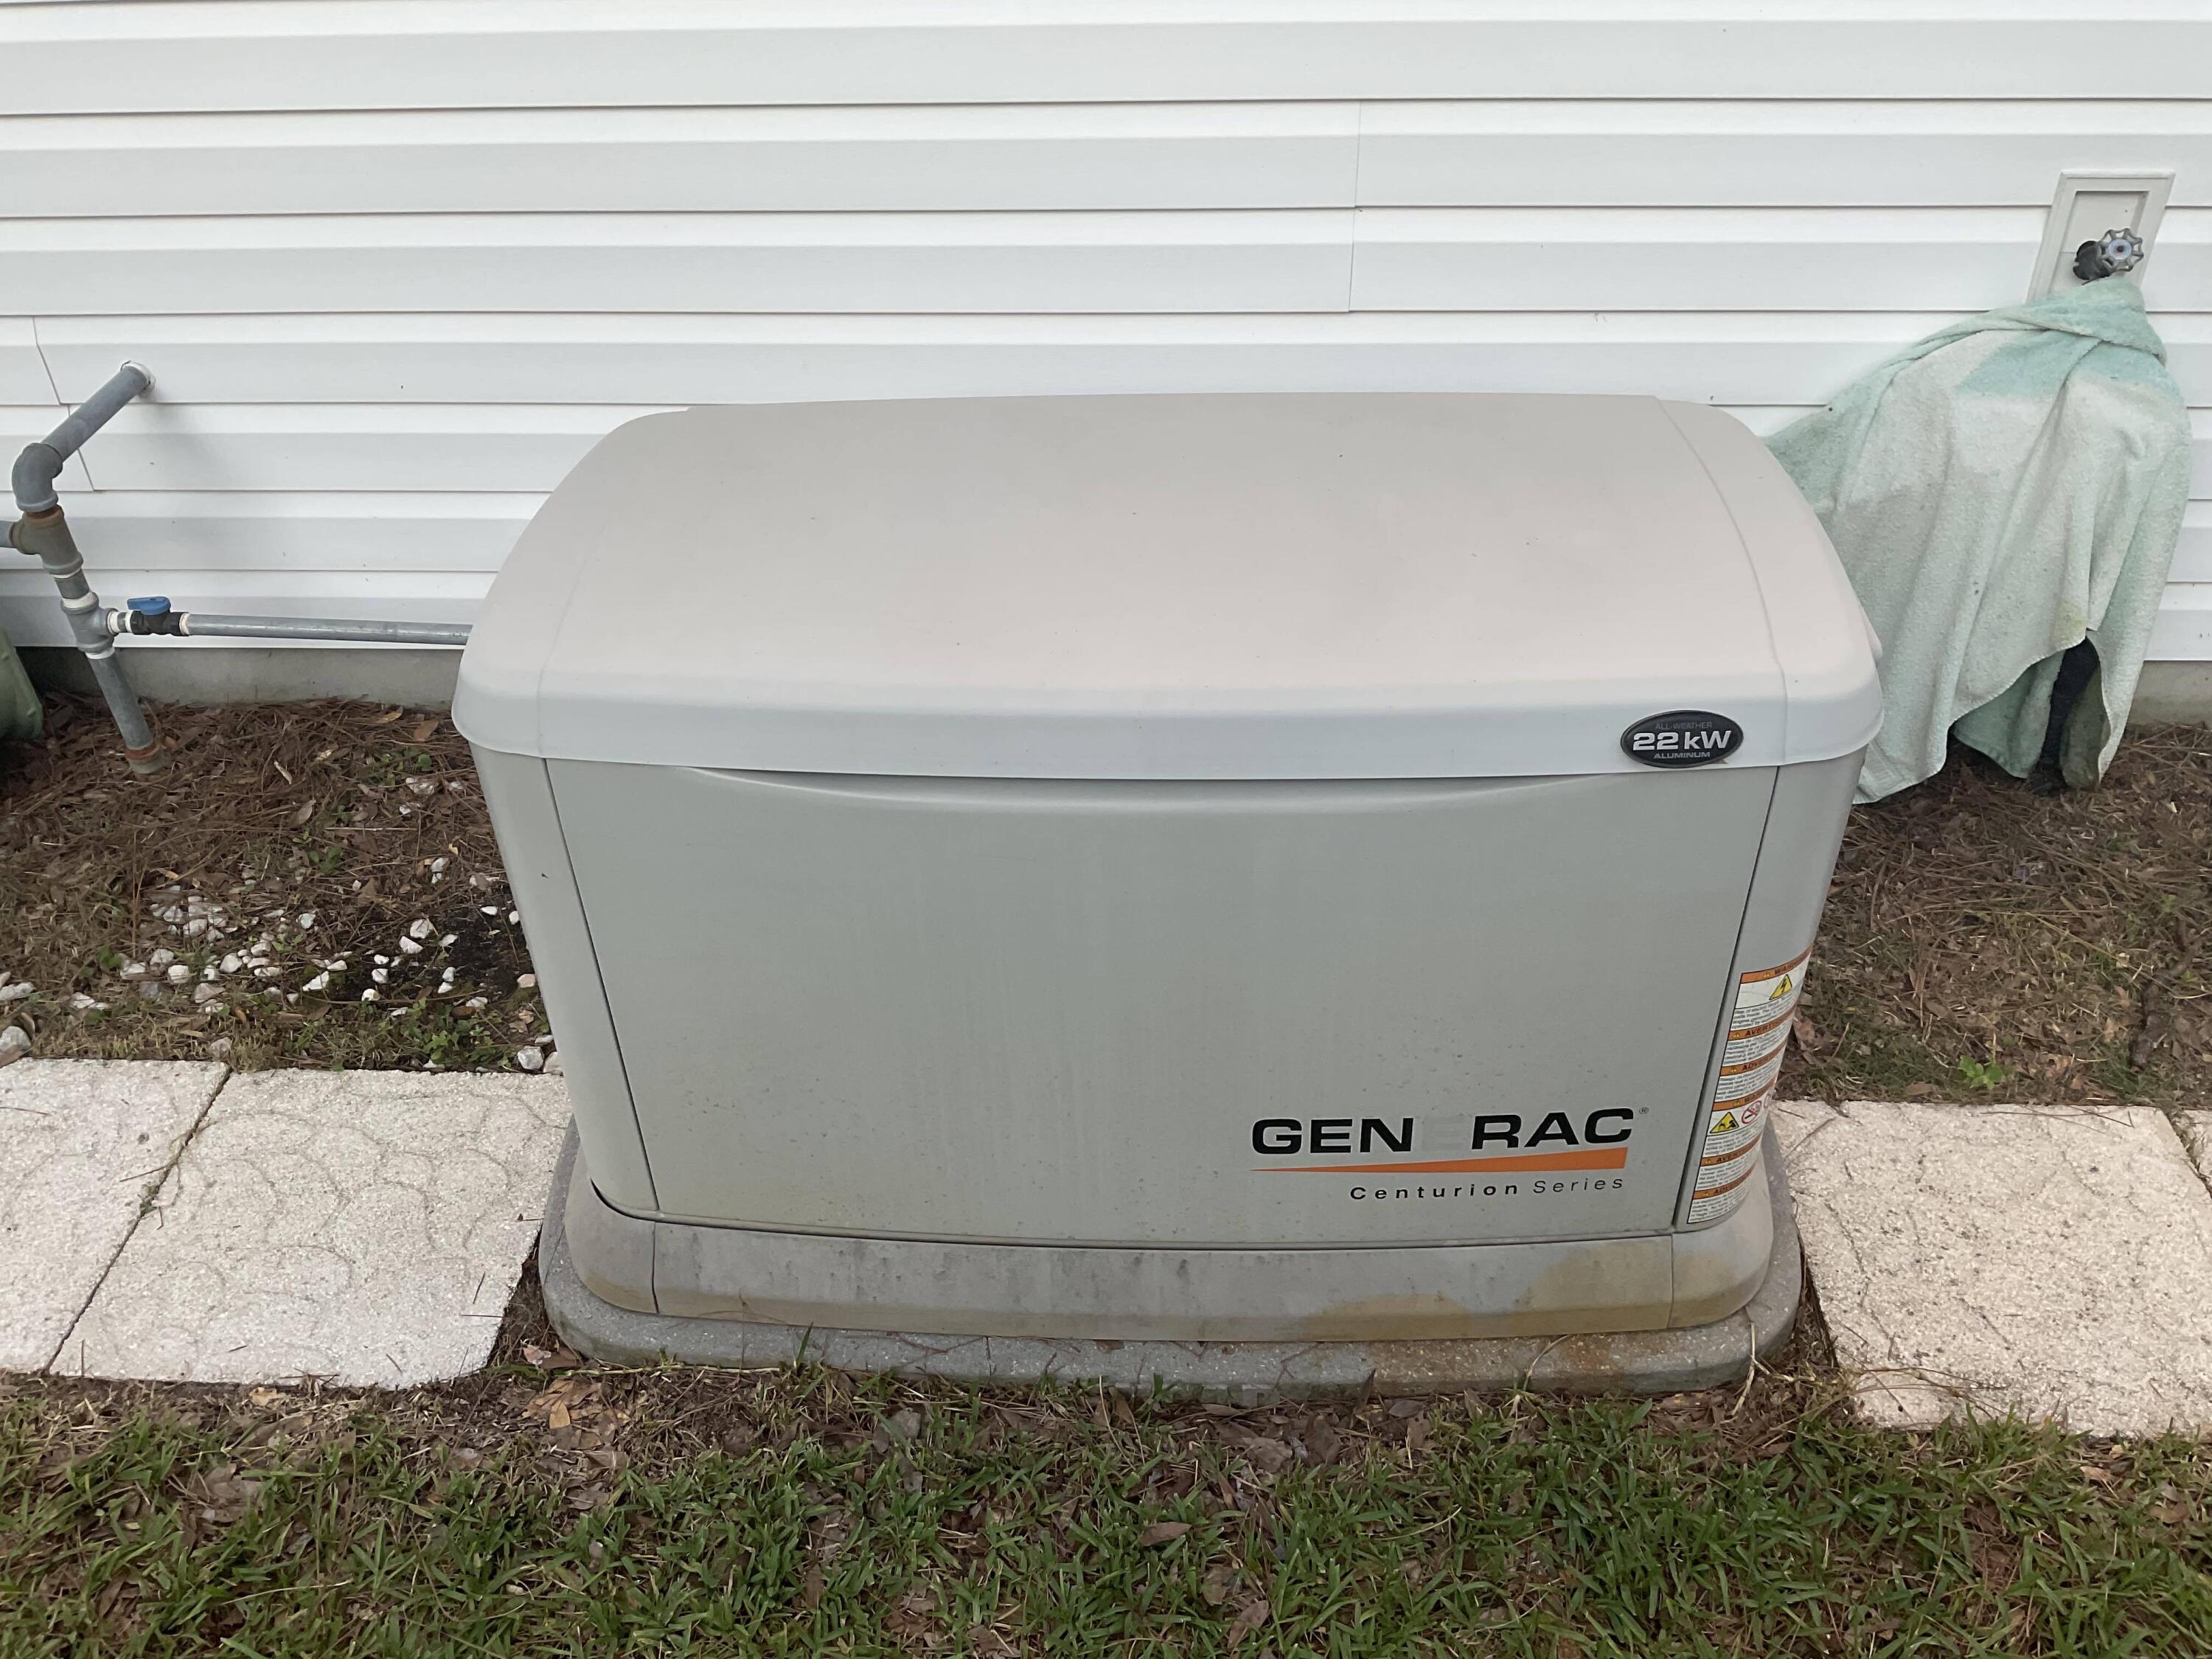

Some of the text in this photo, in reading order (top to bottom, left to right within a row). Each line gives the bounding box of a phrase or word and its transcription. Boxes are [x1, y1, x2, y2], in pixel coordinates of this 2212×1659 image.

[1655, 721, 1713, 730] ALL-WEATHER
[1632, 730, 1732, 751] 22 kW
[1653, 751, 1711, 759] ALUMINUM
[1350, 1176, 1624, 1200] Centurion Series
